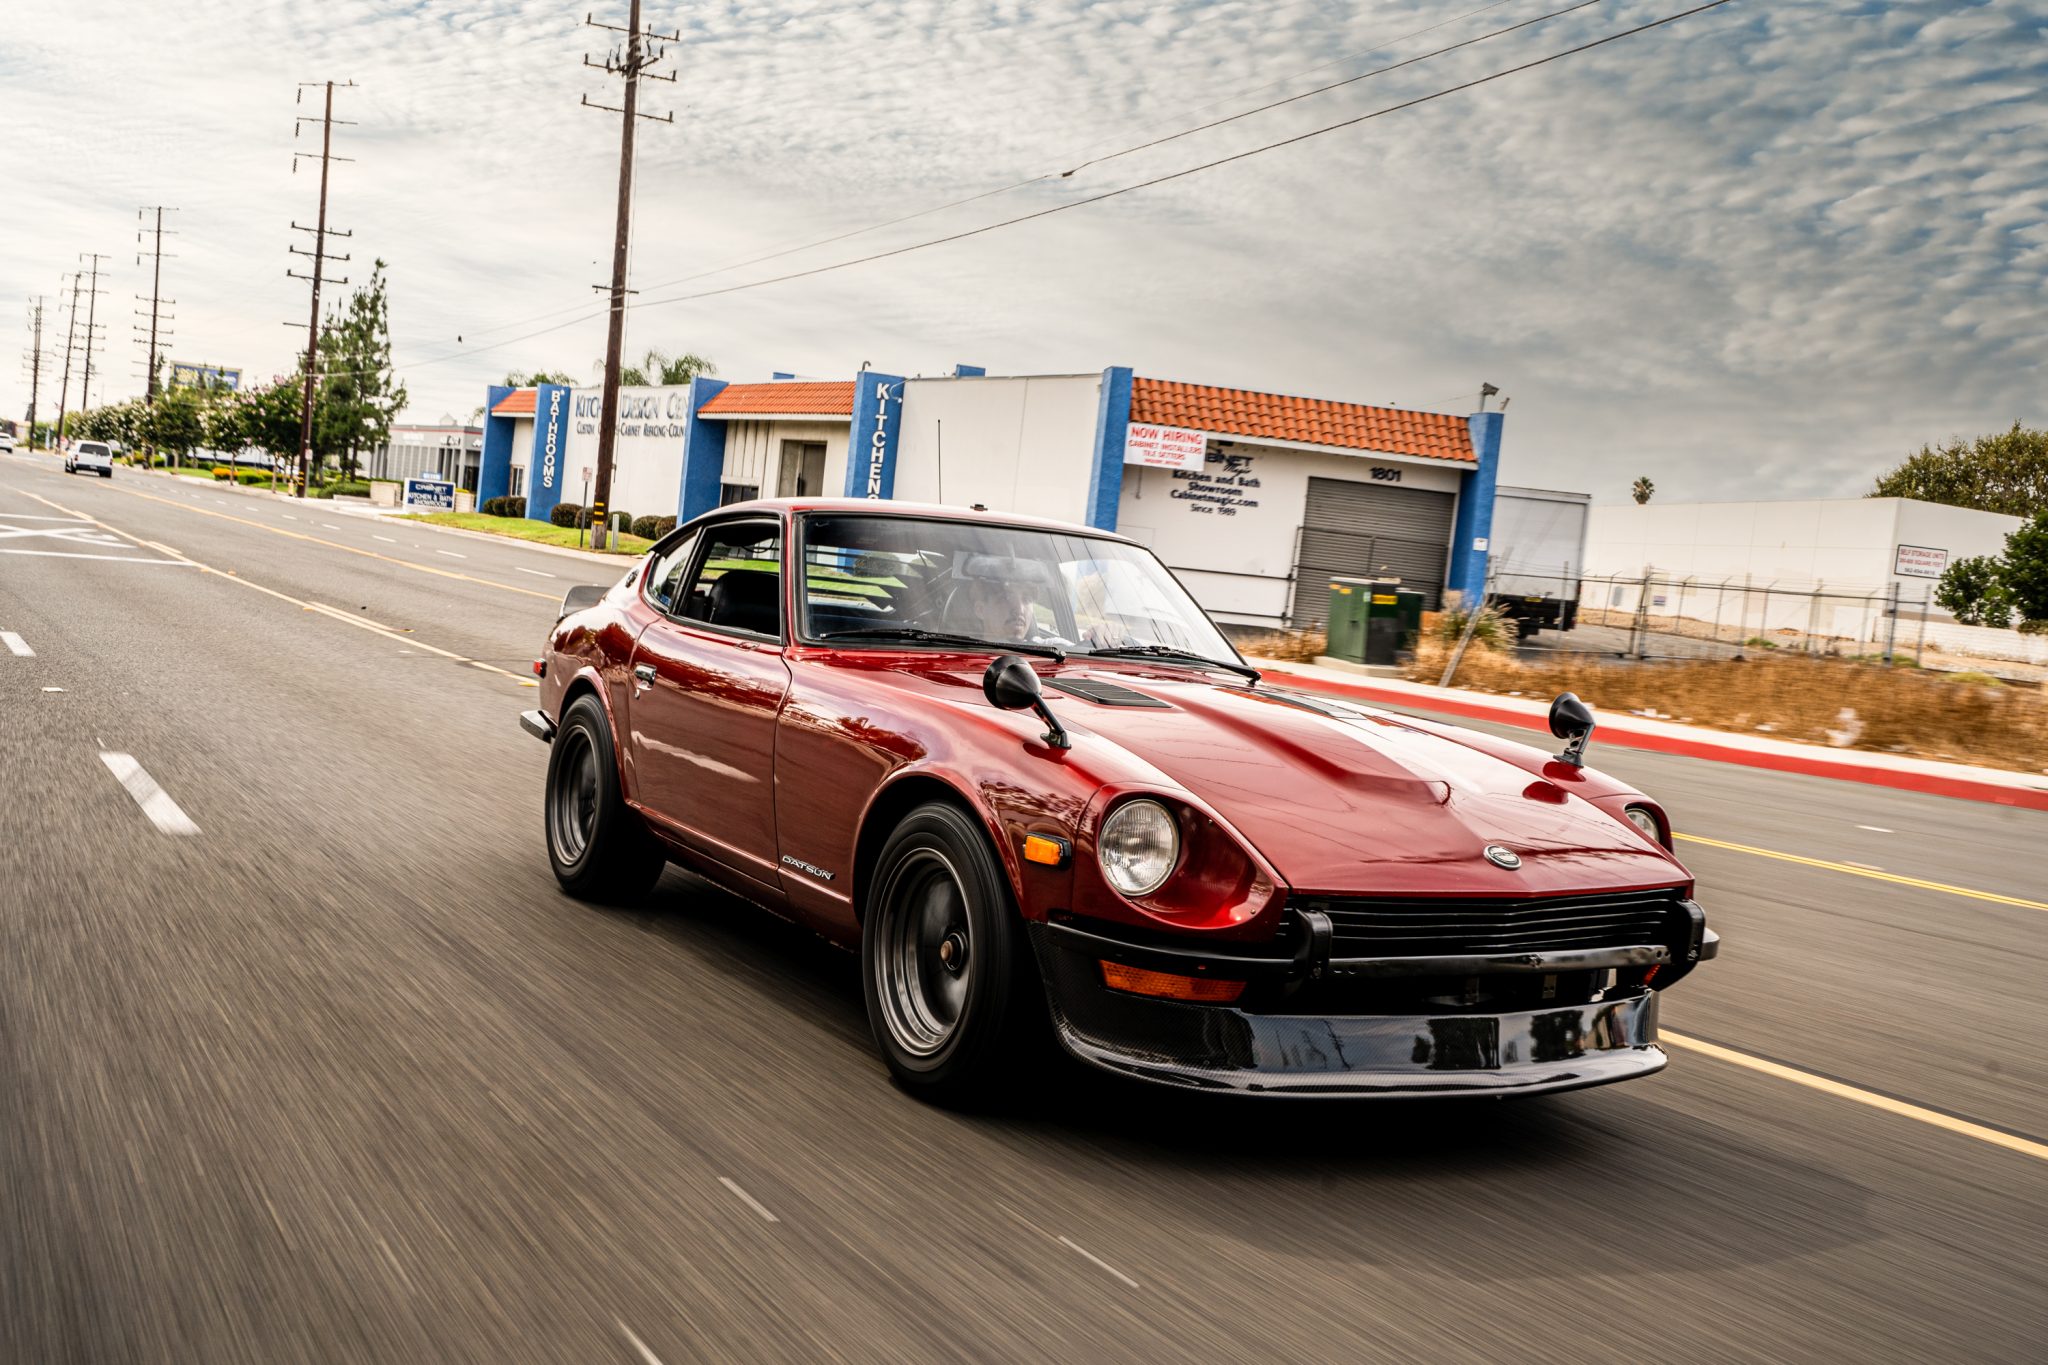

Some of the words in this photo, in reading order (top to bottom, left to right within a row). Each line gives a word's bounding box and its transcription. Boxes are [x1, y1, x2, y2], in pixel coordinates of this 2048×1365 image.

[575, 395, 602, 418] KITCH
[621, 394, 661, 419] DESIGN
[543, 390, 560, 488] BATHROOMS
[1131, 427, 1158, 440] NOW
[1162, 430, 1202, 445] HIRING
[1128, 440, 1159, 449] CABINET
[1162, 443, 1201, 455] INSTALLERS
[1172, 468, 1212, 482] Kitchen
[1215, 475, 1234, 485] and
[1239, 476, 1261, 488] Bath
[1370, 466, 1402, 482] 1801
[1188, 481, 1242, 496] Showroom
[1170, 489, 1258, 507] Cabinetmagic.com
[1190, 503, 1213, 514] Since
[782, 855, 834, 880] DATSUN
